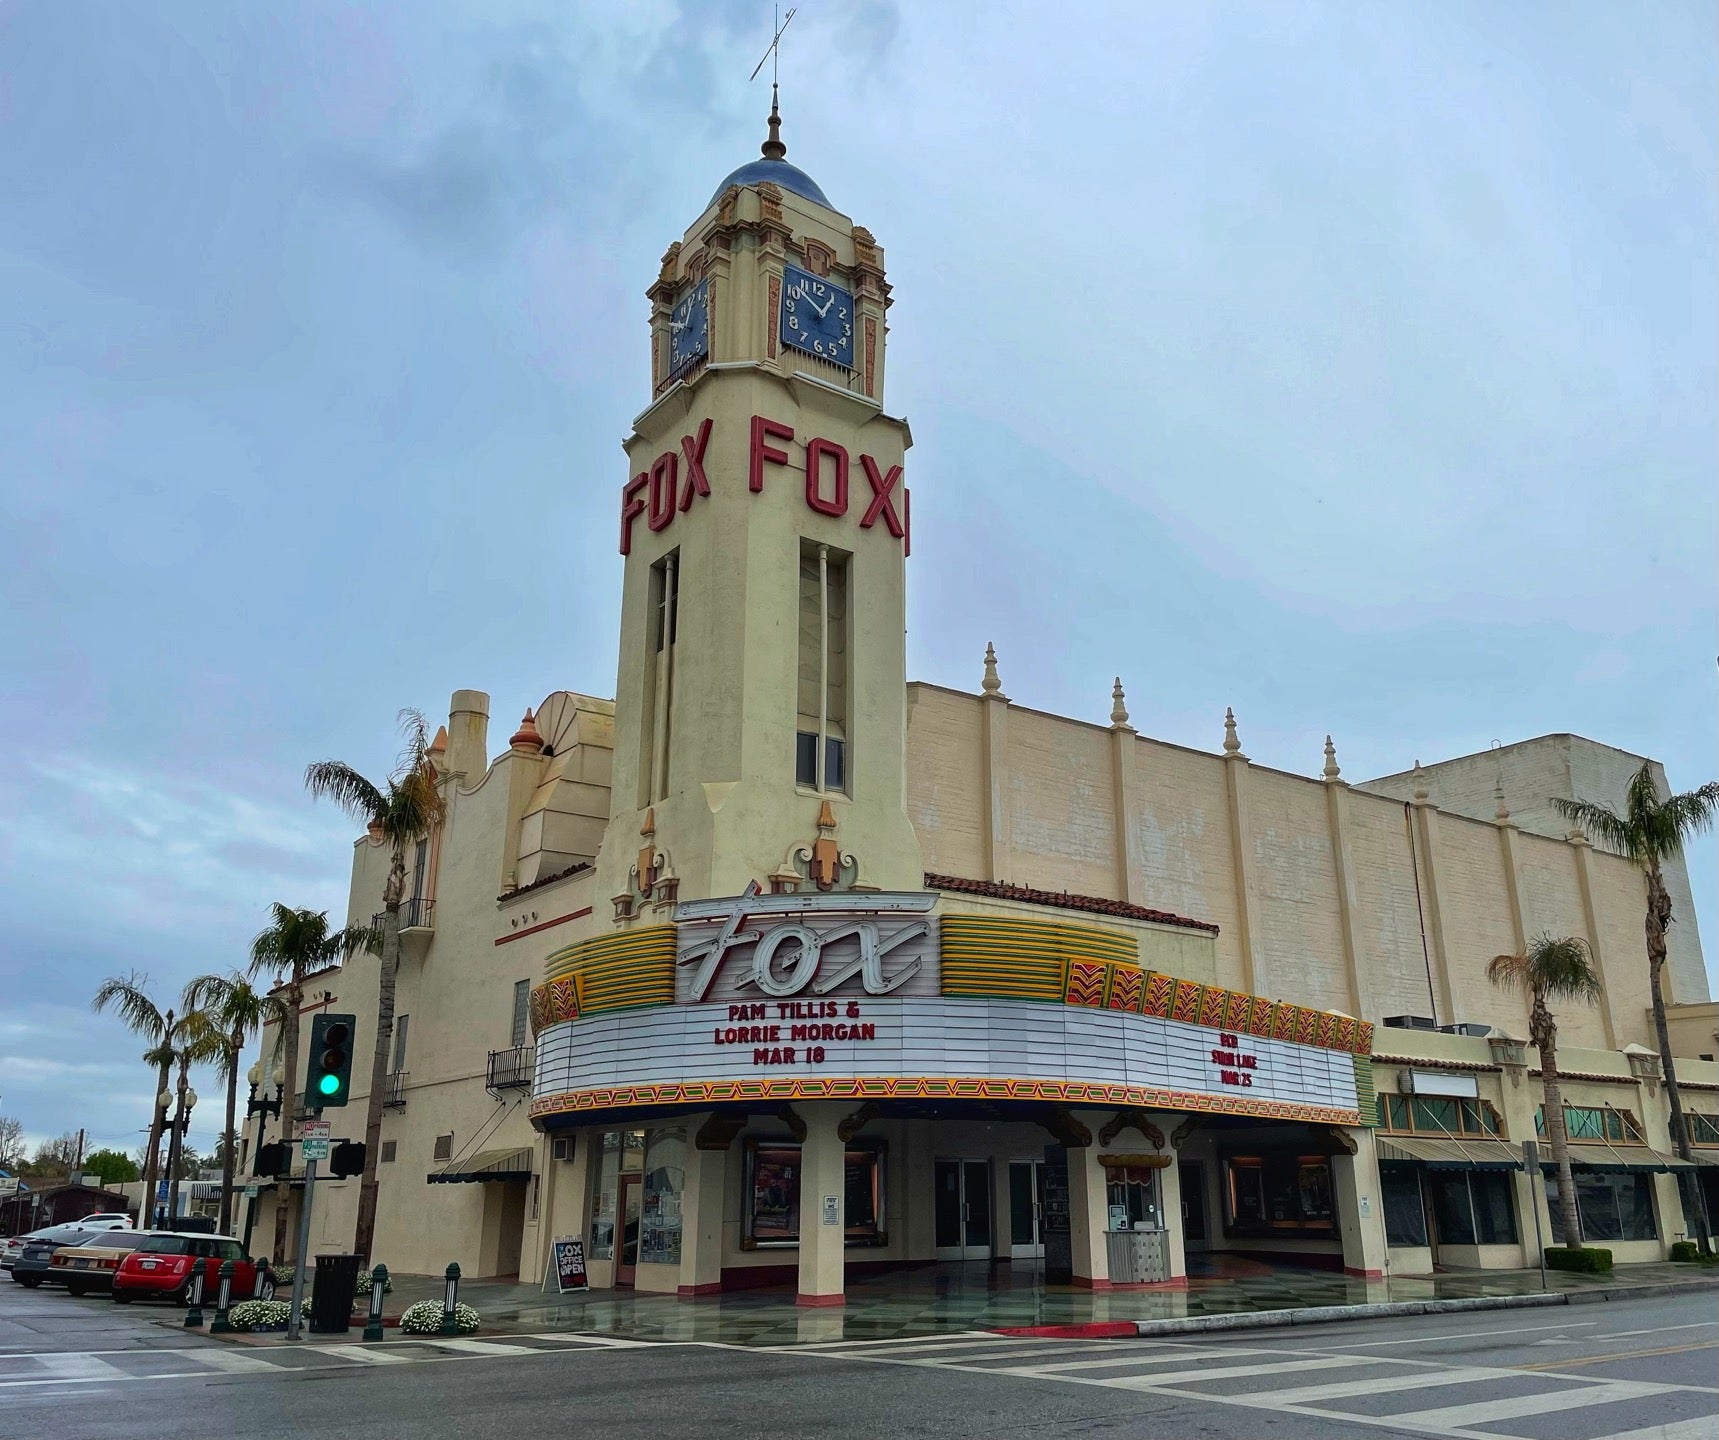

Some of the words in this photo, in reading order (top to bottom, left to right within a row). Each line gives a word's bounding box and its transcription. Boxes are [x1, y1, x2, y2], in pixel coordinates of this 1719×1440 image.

[787, 284, 801, 300] 10
[812, 281, 826, 297] 12
[785, 300, 795, 313] 9
[838, 306, 847, 319] 2
[788, 316, 799, 330] 8
[842, 322, 851, 336] 3
[800, 331, 809, 343] 7
[838, 337, 847, 349] 4
[813, 340, 823, 353] 6
[829, 342, 838, 356] 5
[749, 415, 904, 538] FOX
[619, 417, 713, 555] FOX
[728, 1004, 766, 1021] PAM
[777, 1002, 838, 1019] TILLIS
[845, 1001, 860, 1017] &
[714, 1027, 781, 1045] LORRIE
[790, 1023, 875, 1042] MORGAN
[753, 1047, 796, 1065] MAR
[805, 1046, 825, 1063] 18
[1220, 1070, 1240, 1086] MAR
[1241, 1072, 1253, 1087] 25
[305, 1122, 314, 1130] NO
[560, 1255, 583, 1265] OFFICE
[560, 1264, 584, 1276] OPEN
